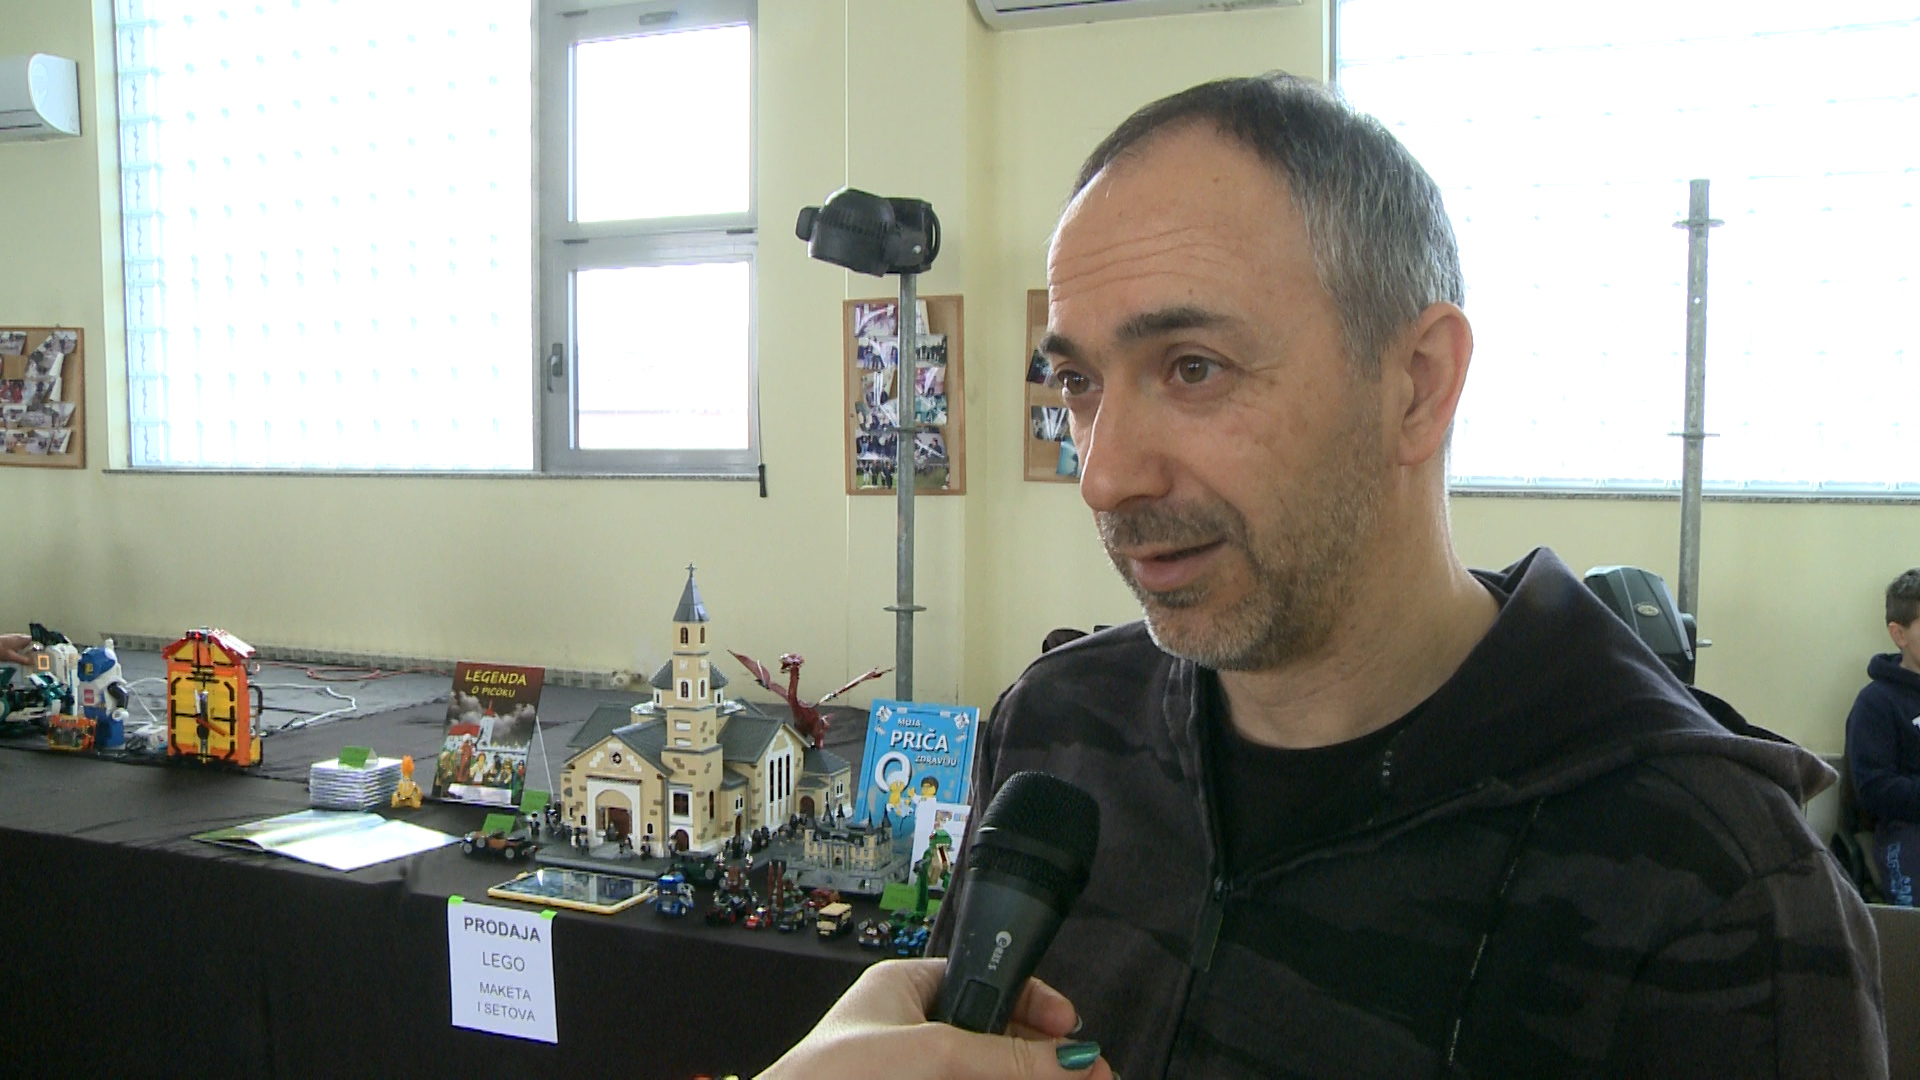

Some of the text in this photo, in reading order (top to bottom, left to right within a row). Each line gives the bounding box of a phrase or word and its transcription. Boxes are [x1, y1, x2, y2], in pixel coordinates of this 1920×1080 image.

[465, 669, 527, 686] LEGENDA
[471, 685, 479, 695] O
[897, 717, 922, 728] MOJA
[890, 727, 949, 753] PRIČA
[463, 915, 541, 943] PRODAJA
[482, 951, 526, 972] LEGO
[479, 981, 532, 1001] MAKETA
[477, 1001, 536, 1022] I SETOVA
